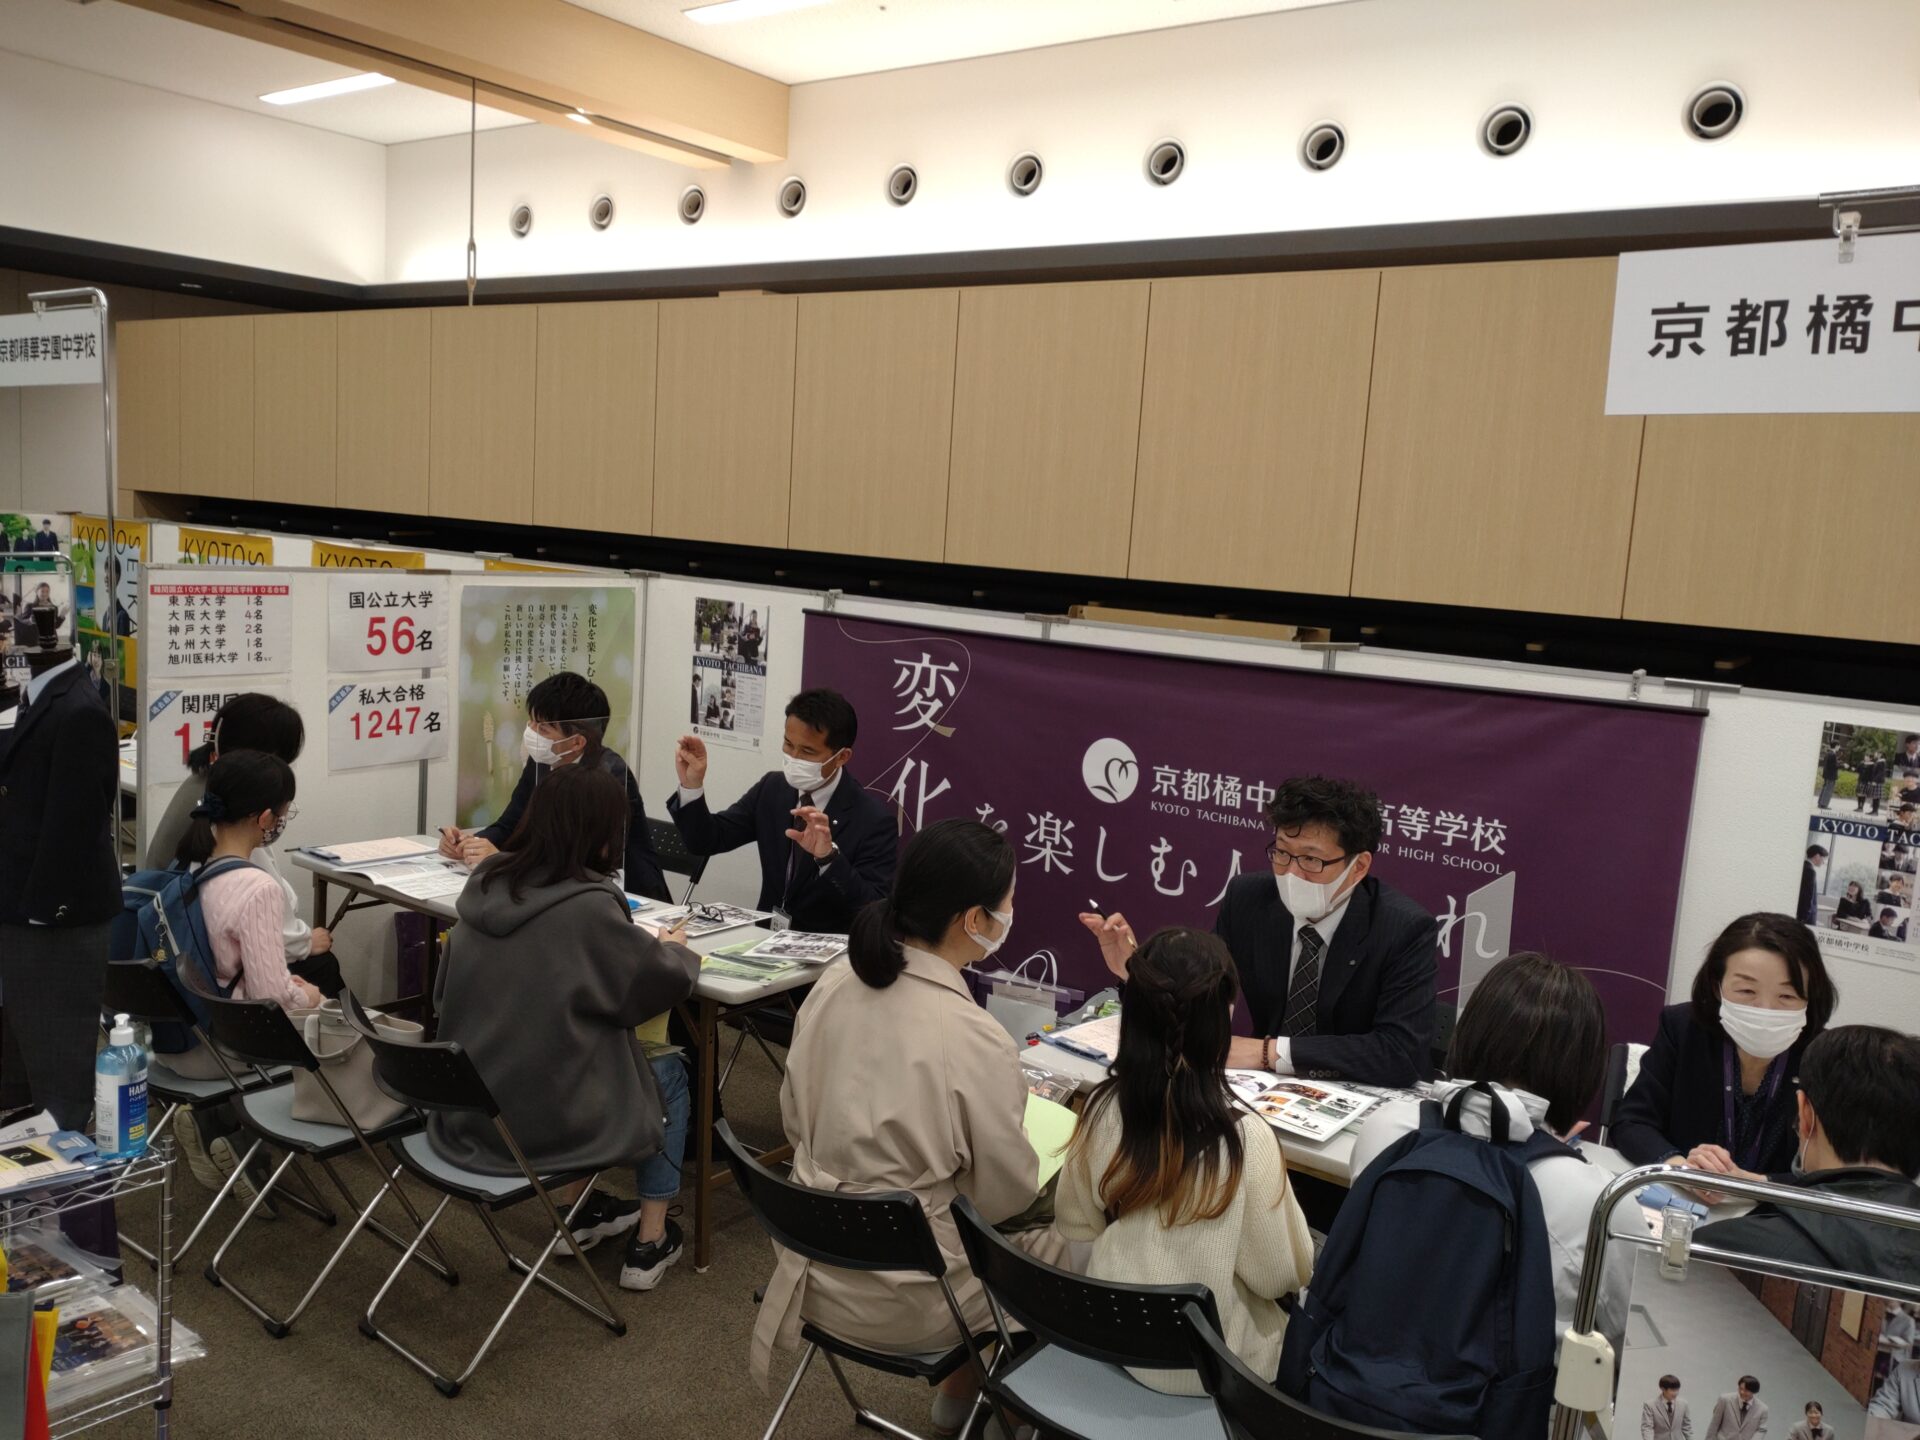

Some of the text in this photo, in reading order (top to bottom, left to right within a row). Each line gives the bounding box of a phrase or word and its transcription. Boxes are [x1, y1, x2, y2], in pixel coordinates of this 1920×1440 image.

[77, 525, 126, 556] KYOO
[168, 595, 226, 607] 東京大学
[349, 591, 433, 609] 国公立大学
[168, 609, 263, 621] 大阪大学 4名
[168, 623, 263, 636] 神戸大学 2名
[366, 615, 433, 656] 56名
[168, 638, 226, 650] 九州大学
[586, 603, 598, 685] 変化を楽しむ
[168, 652, 239, 665] 旭川医科大学
[359, 684, 426, 706] 私大合格
[350, 706, 441, 741] 1247名
[1151, 800, 1190, 817] KYOTO
[1196, 808, 1265, 832] TACHIBANA
[1398, 846, 1435, 863] HIGH
[1442, 854, 1503, 876] SCHOOL
[1818, 817, 1879, 840] KYOTO
